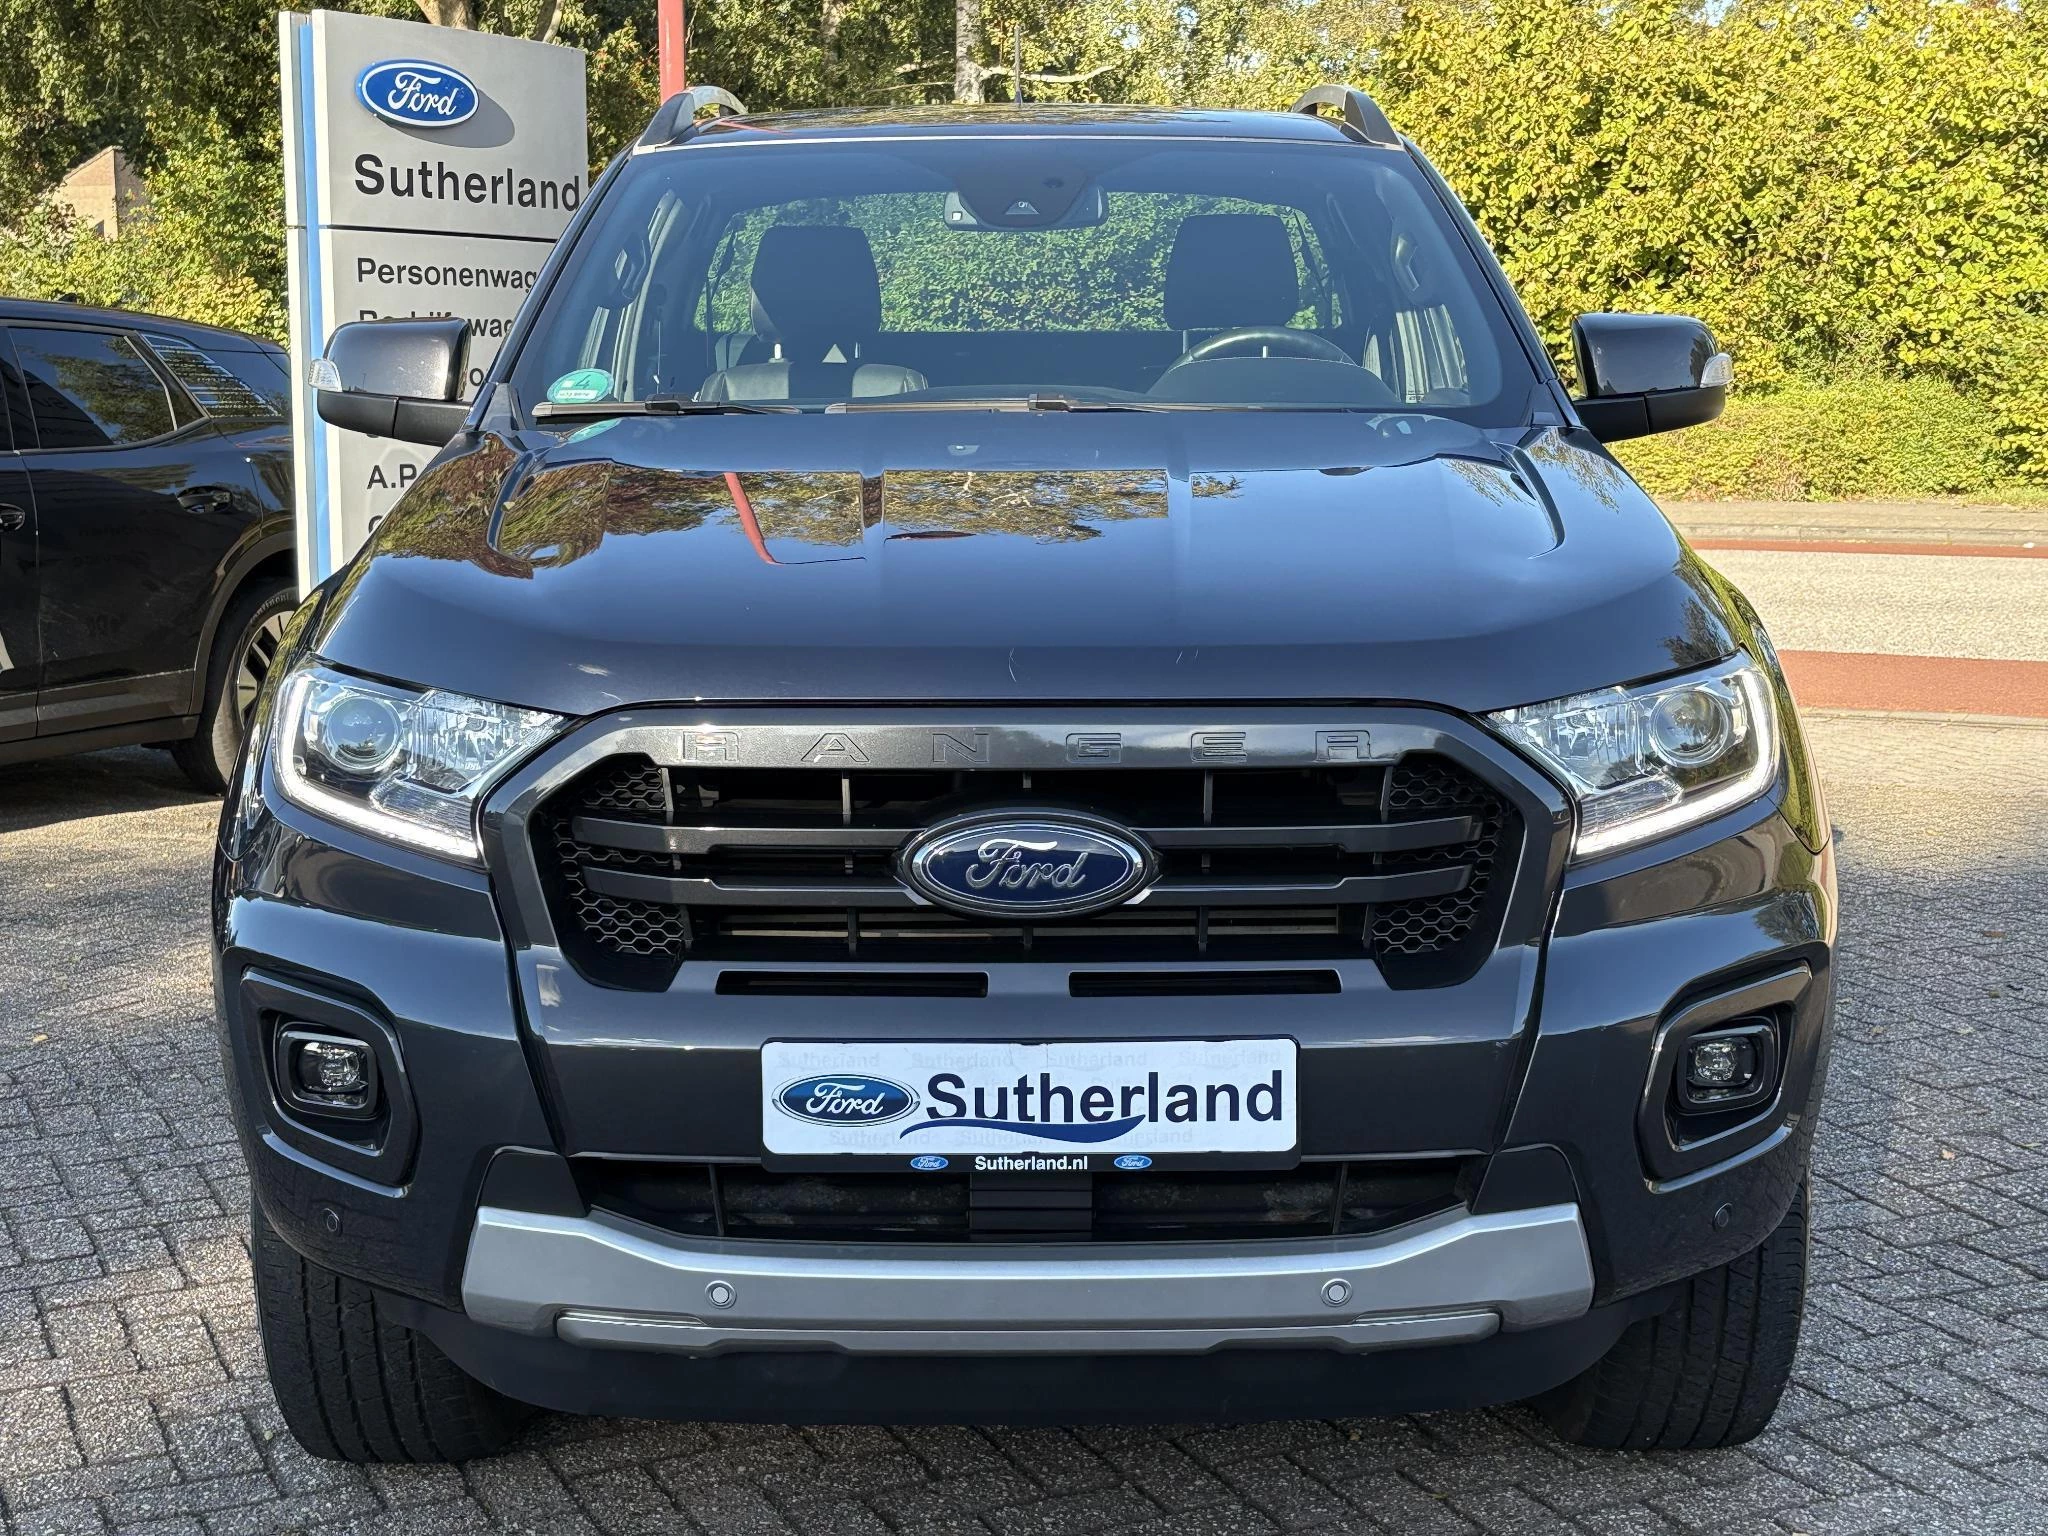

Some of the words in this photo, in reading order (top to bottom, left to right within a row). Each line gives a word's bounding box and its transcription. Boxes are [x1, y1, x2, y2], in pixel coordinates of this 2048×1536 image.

[387, 71, 457, 116] Ford
[354, 153, 580, 212] Sutherland
[682, 730, 1371, 764] RANGER
[965, 838, 1088, 889] Ford
[806, 1082, 885, 1115] Ford
[925, 1069, 1283, 1123] Sutherland
[974, 1156, 1088, 1170] Sutherland.nl
